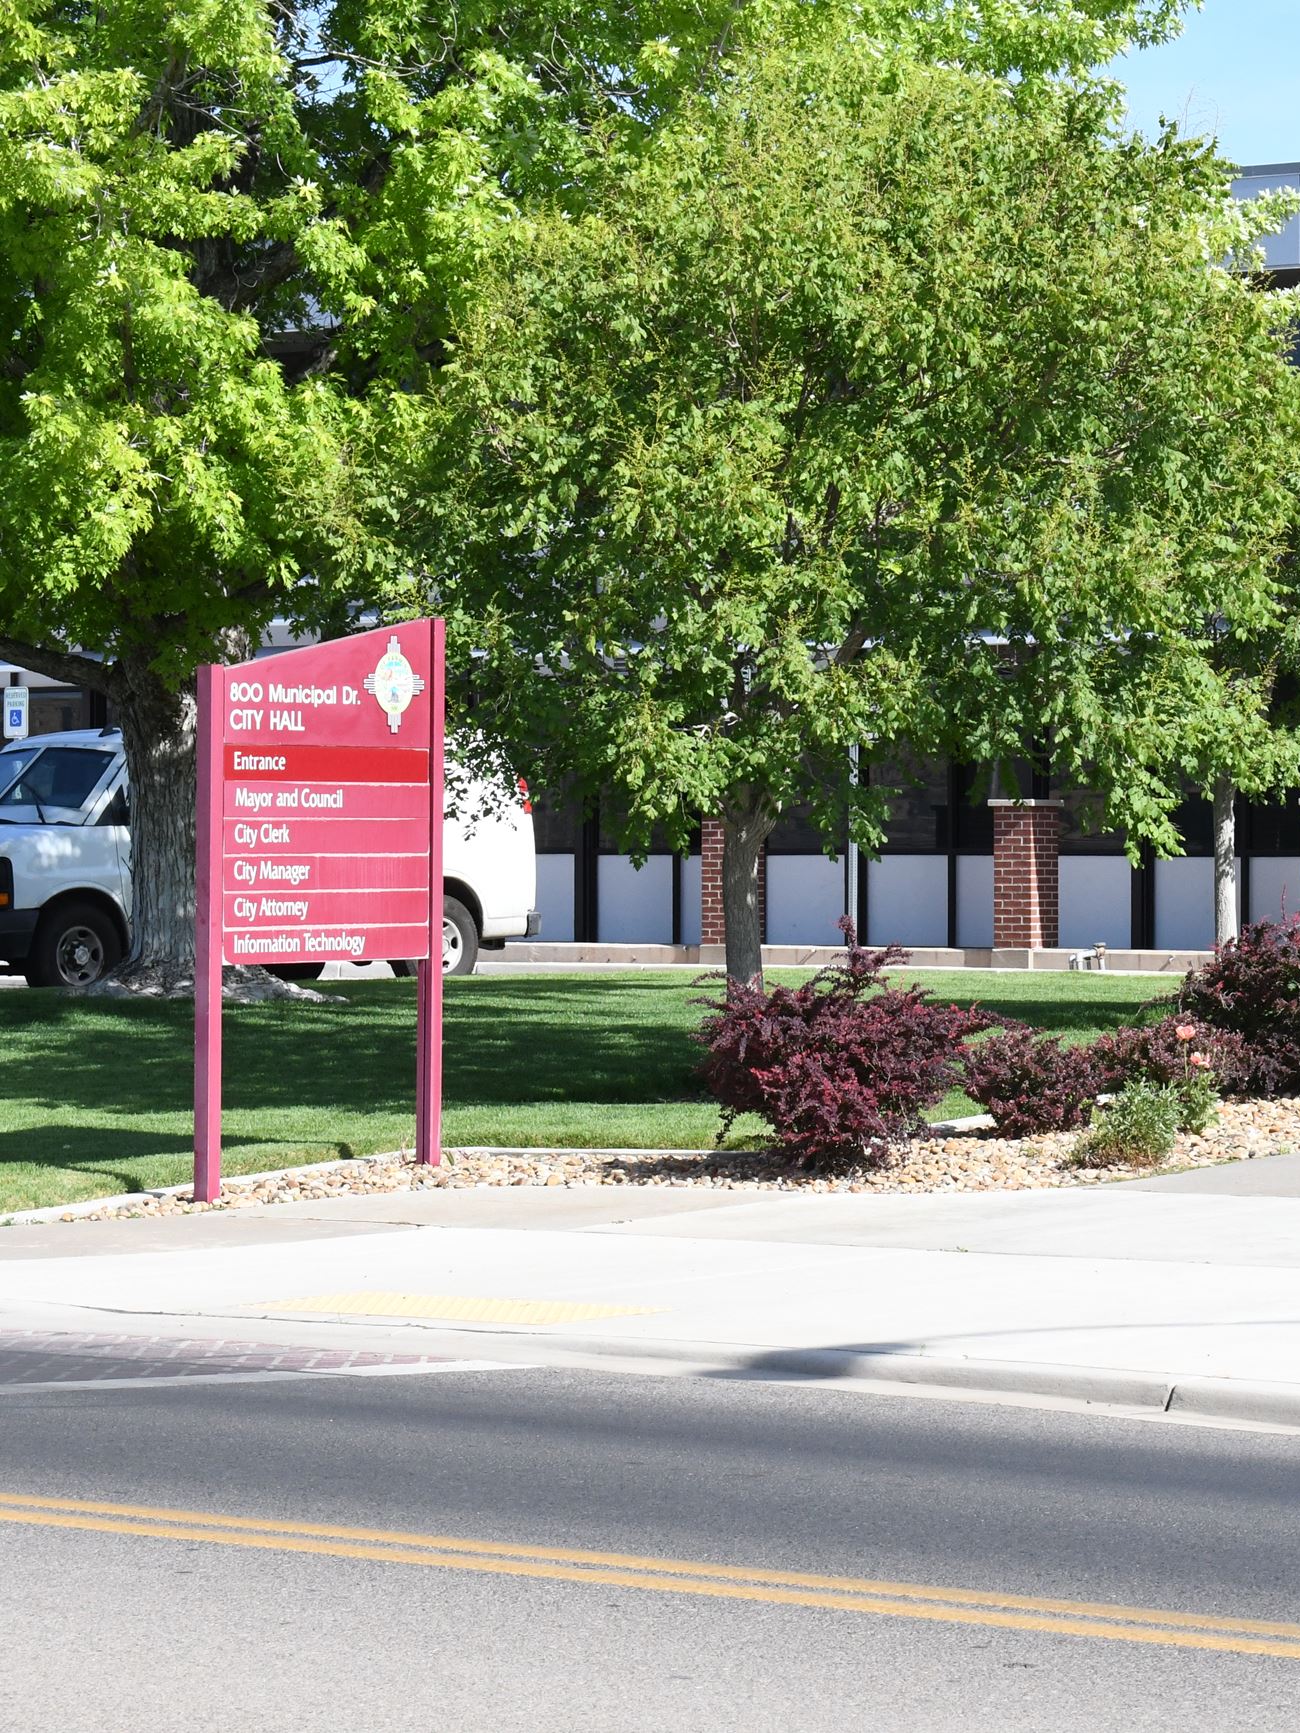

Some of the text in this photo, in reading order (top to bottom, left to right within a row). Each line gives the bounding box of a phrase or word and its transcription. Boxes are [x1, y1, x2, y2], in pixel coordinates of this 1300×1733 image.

[230, 682, 361, 708] 800 Municipal Dr.
[229, 709, 305, 731] CITY HALL
[233, 751, 286, 770] Entrance
[235, 788, 343, 812] Mayor and Council
[234, 823, 290, 848] City Clerk
[233, 860, 310, 885] City Manager
[233, 897, 309, 922] City Attorney
[233, 931, 366, 955] Information Technology
